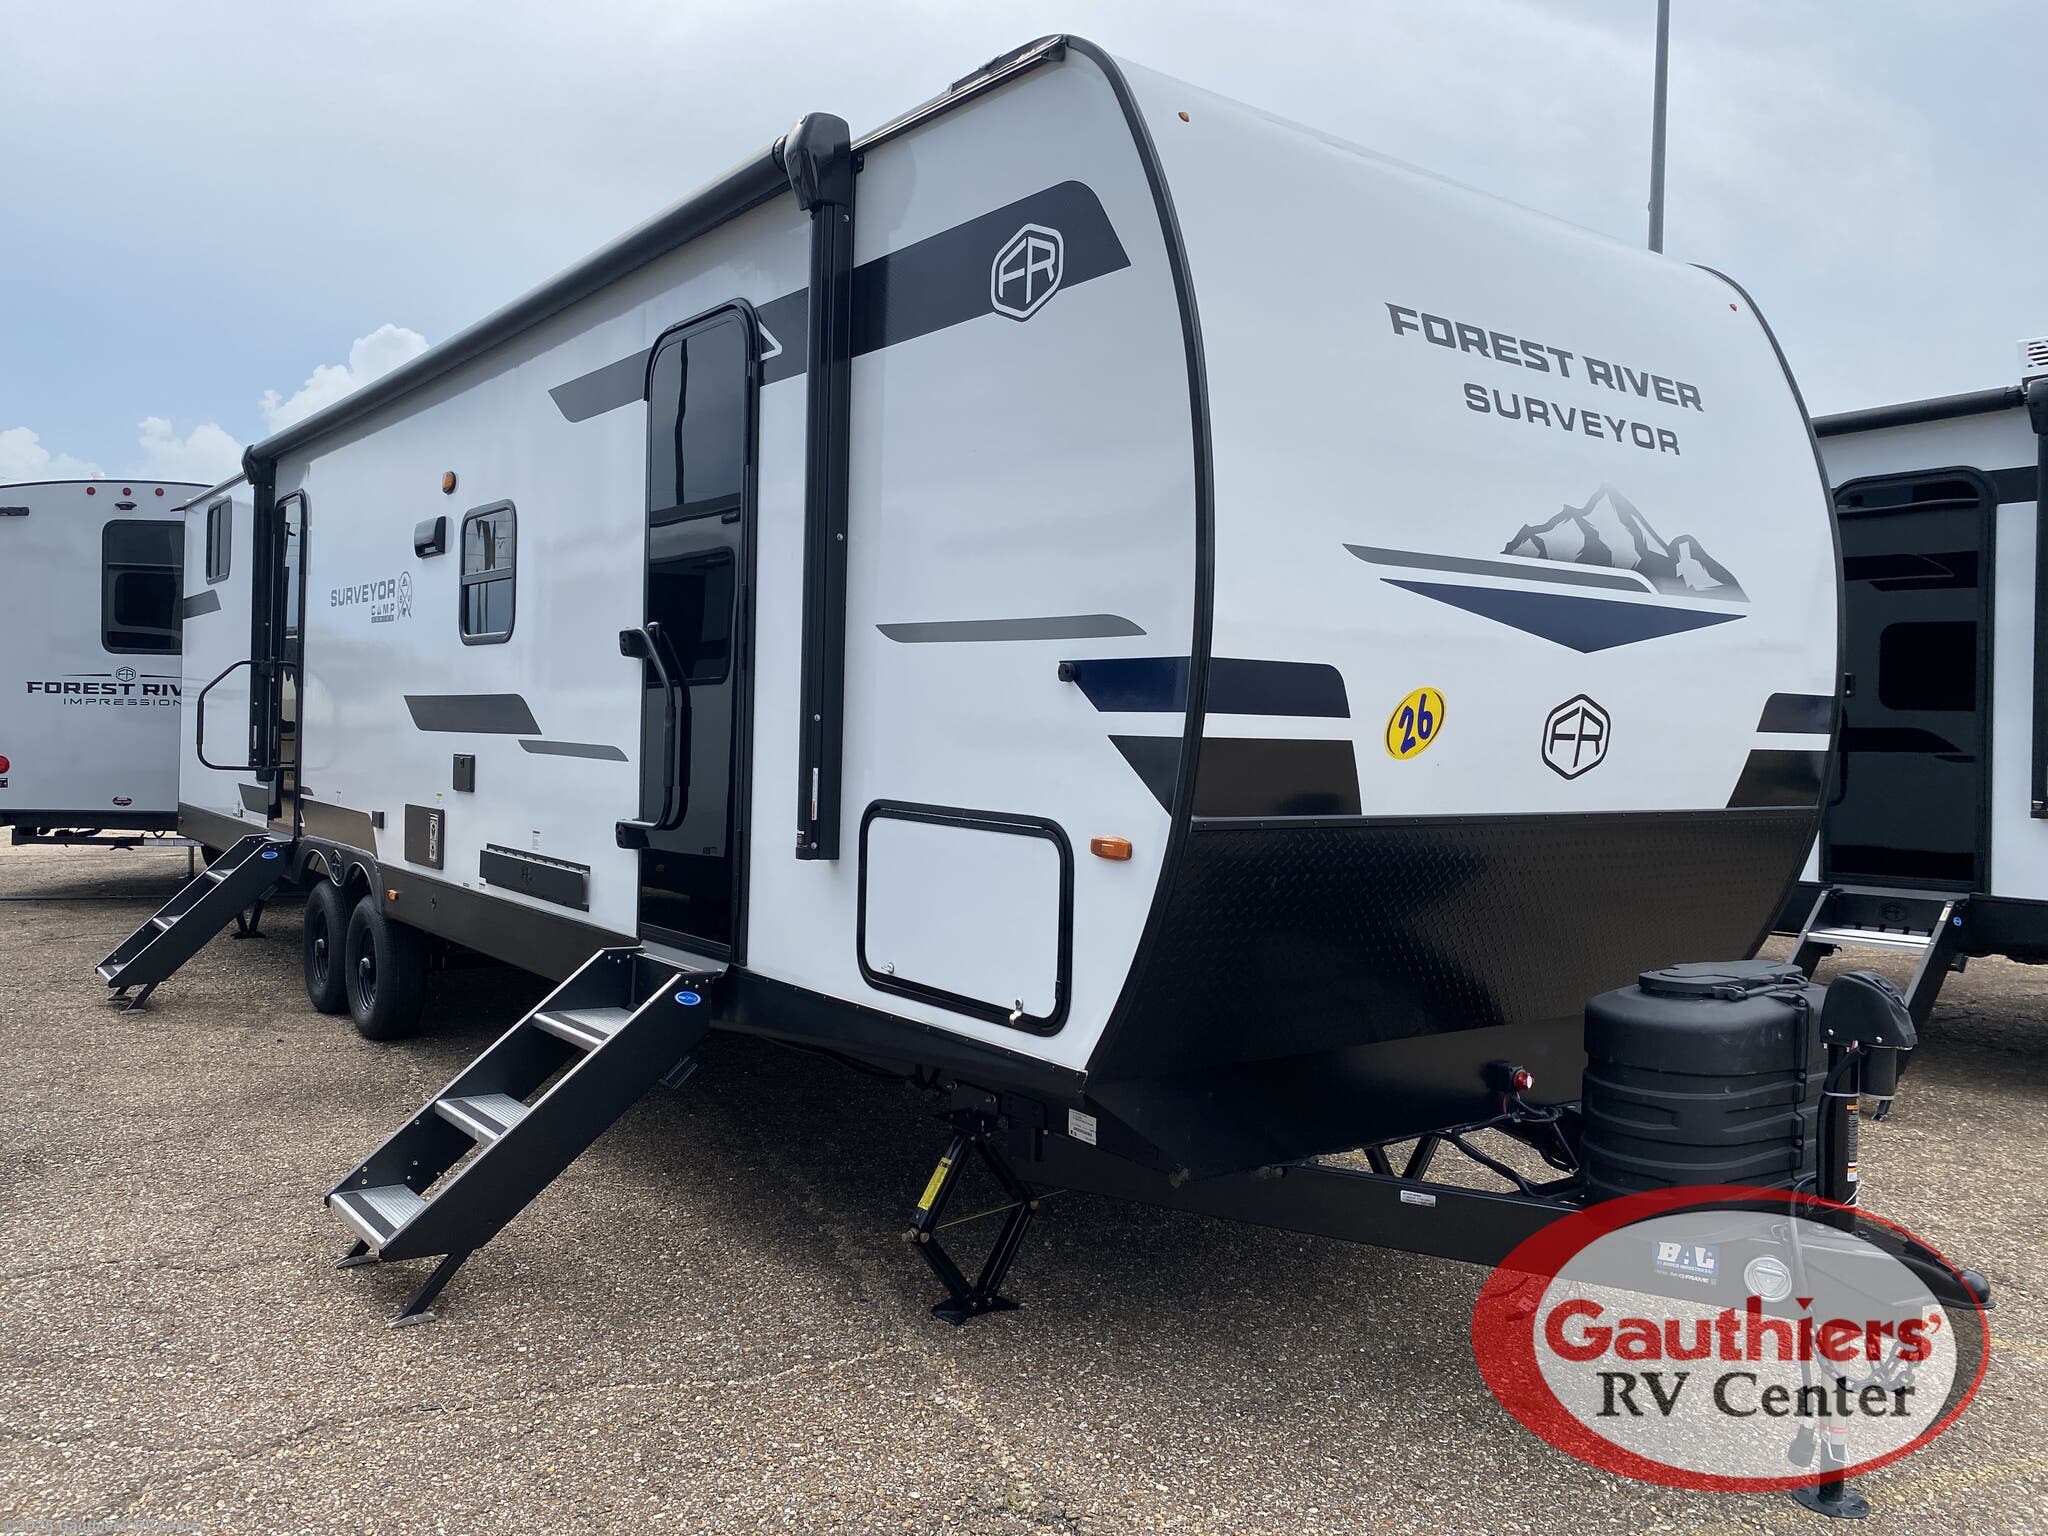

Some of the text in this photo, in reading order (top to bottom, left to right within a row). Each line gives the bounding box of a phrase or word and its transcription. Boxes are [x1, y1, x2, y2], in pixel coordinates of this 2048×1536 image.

[1384, 302, 1705, 412] FOREST RIVER
[1462, 382, 1681, 456] SURVEYOR
[330, 579, 396, 607] SURVEYOR
[26, 681, 136, 696] FOREST
[1398, 693, 1434, 754] 26
